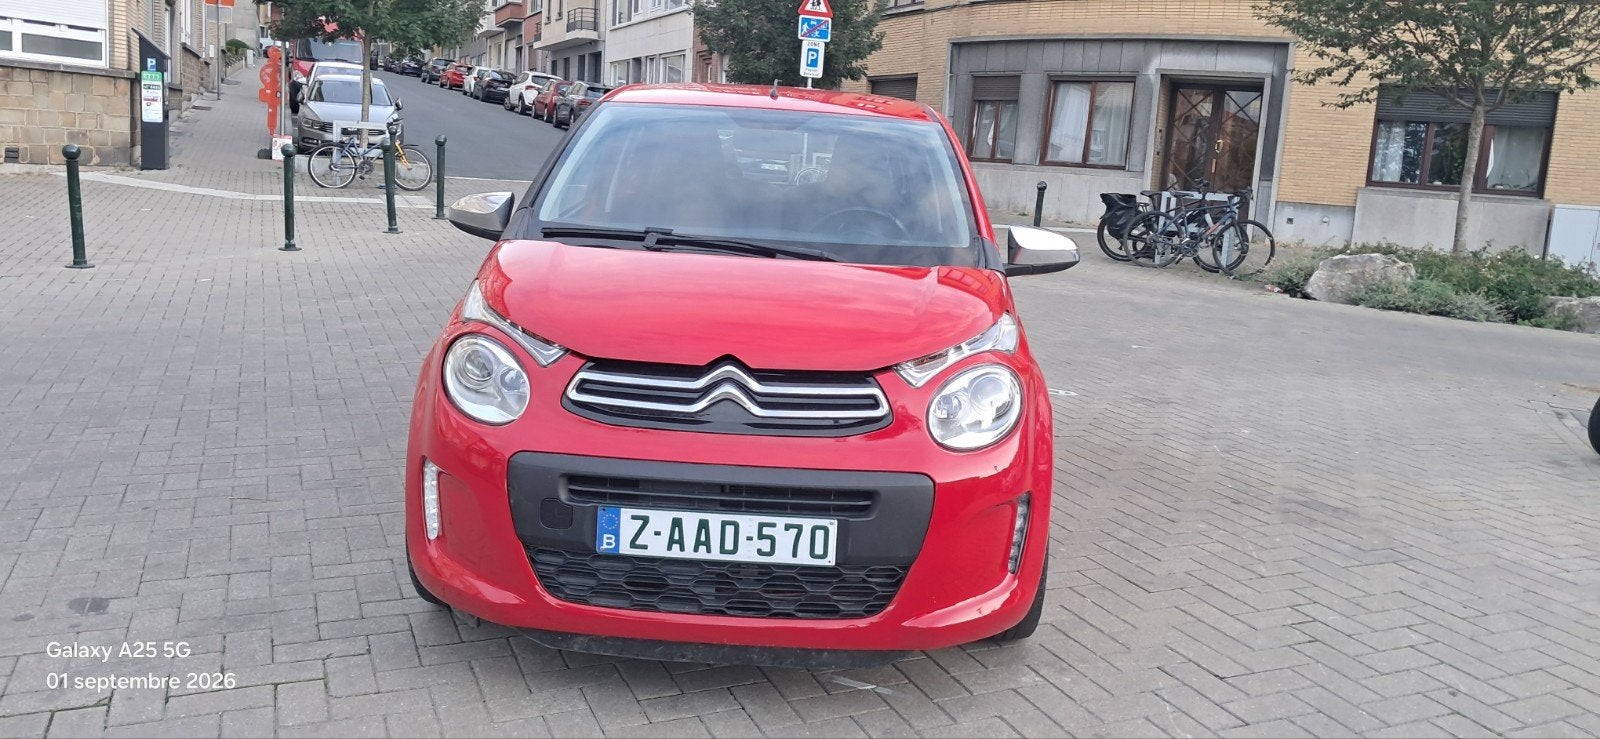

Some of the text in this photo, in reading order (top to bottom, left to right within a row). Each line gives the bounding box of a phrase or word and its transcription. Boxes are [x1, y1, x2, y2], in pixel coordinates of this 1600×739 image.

[147, 58, 156, 70] P
[808, 51, 817, 65] P
[603, 534, 616, 549] B
[629, 514, 830, 560] Z-AAD-570
